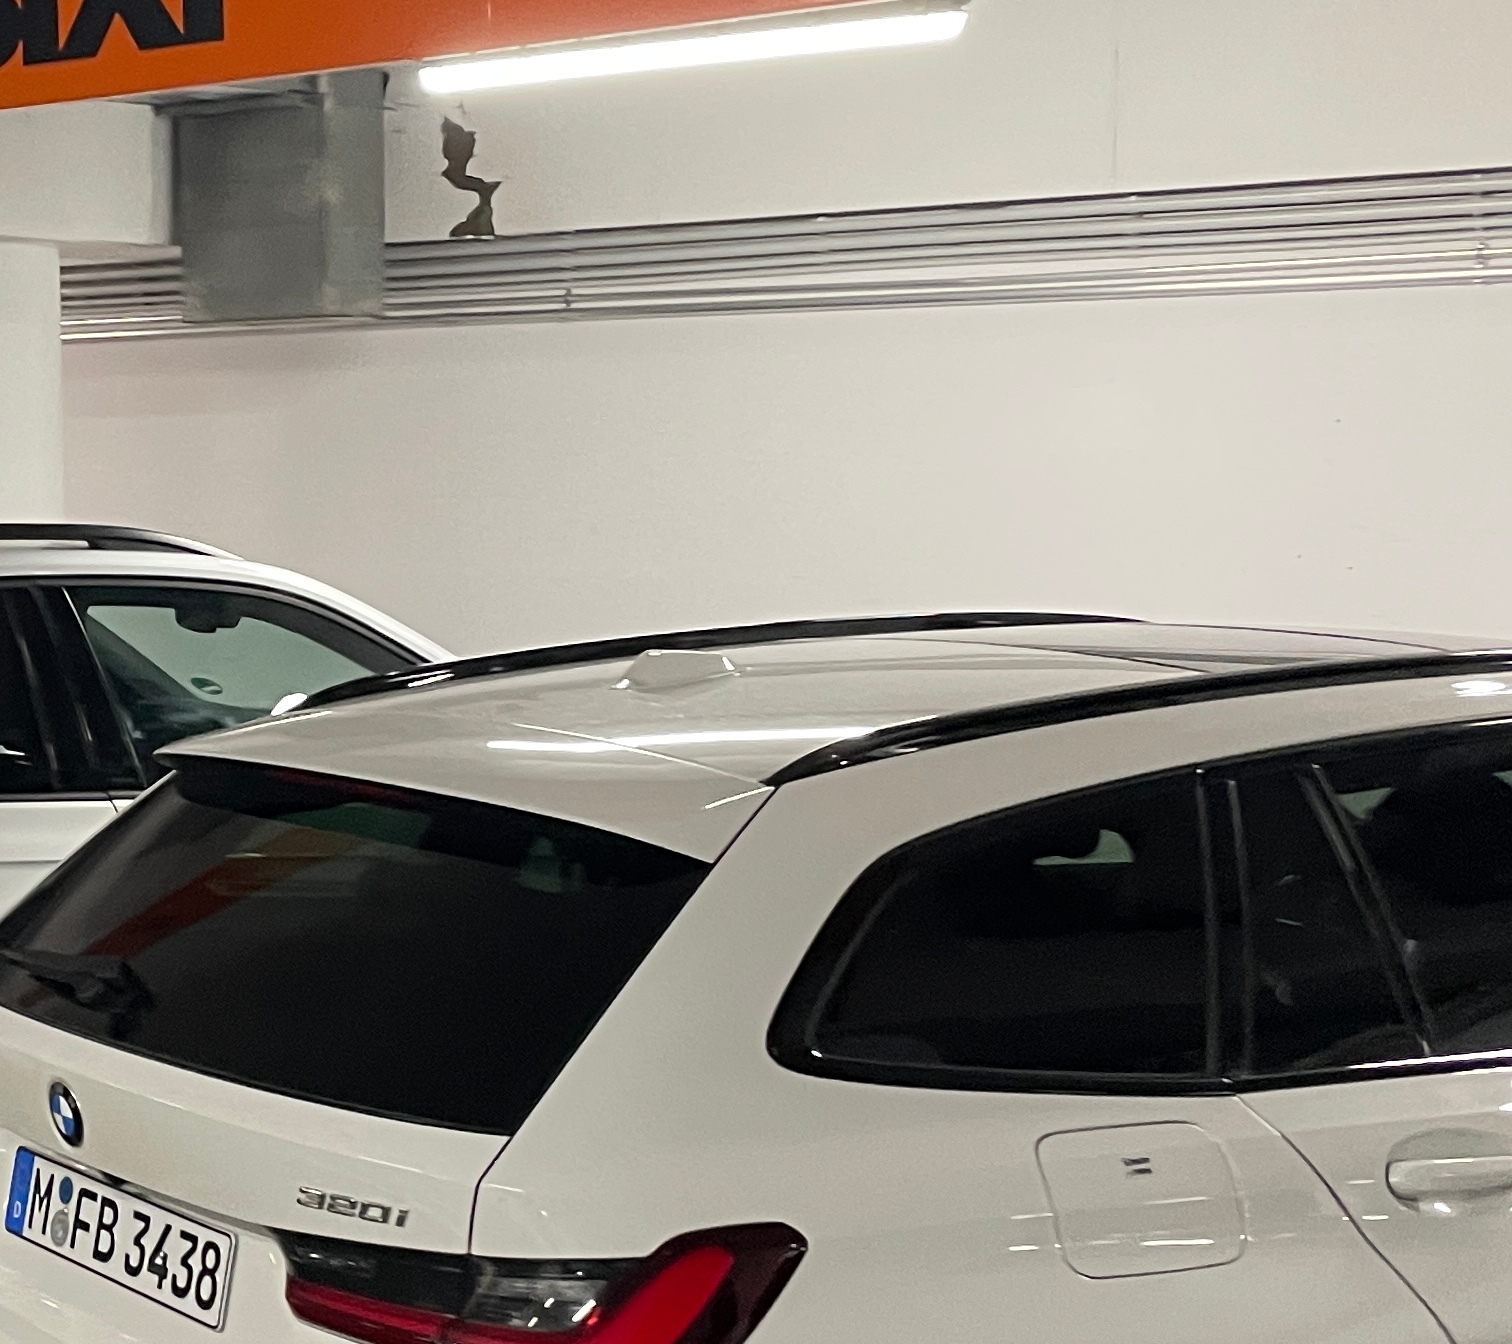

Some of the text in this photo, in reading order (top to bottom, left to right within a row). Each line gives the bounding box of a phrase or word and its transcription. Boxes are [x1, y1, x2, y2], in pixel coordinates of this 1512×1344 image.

[28, 1167, 55, 1236] M
[69, 1187, 119, 1264] FB
[124, 1209, 222, 1311] 3438
[296, 1186, 410, 1228] 320i
